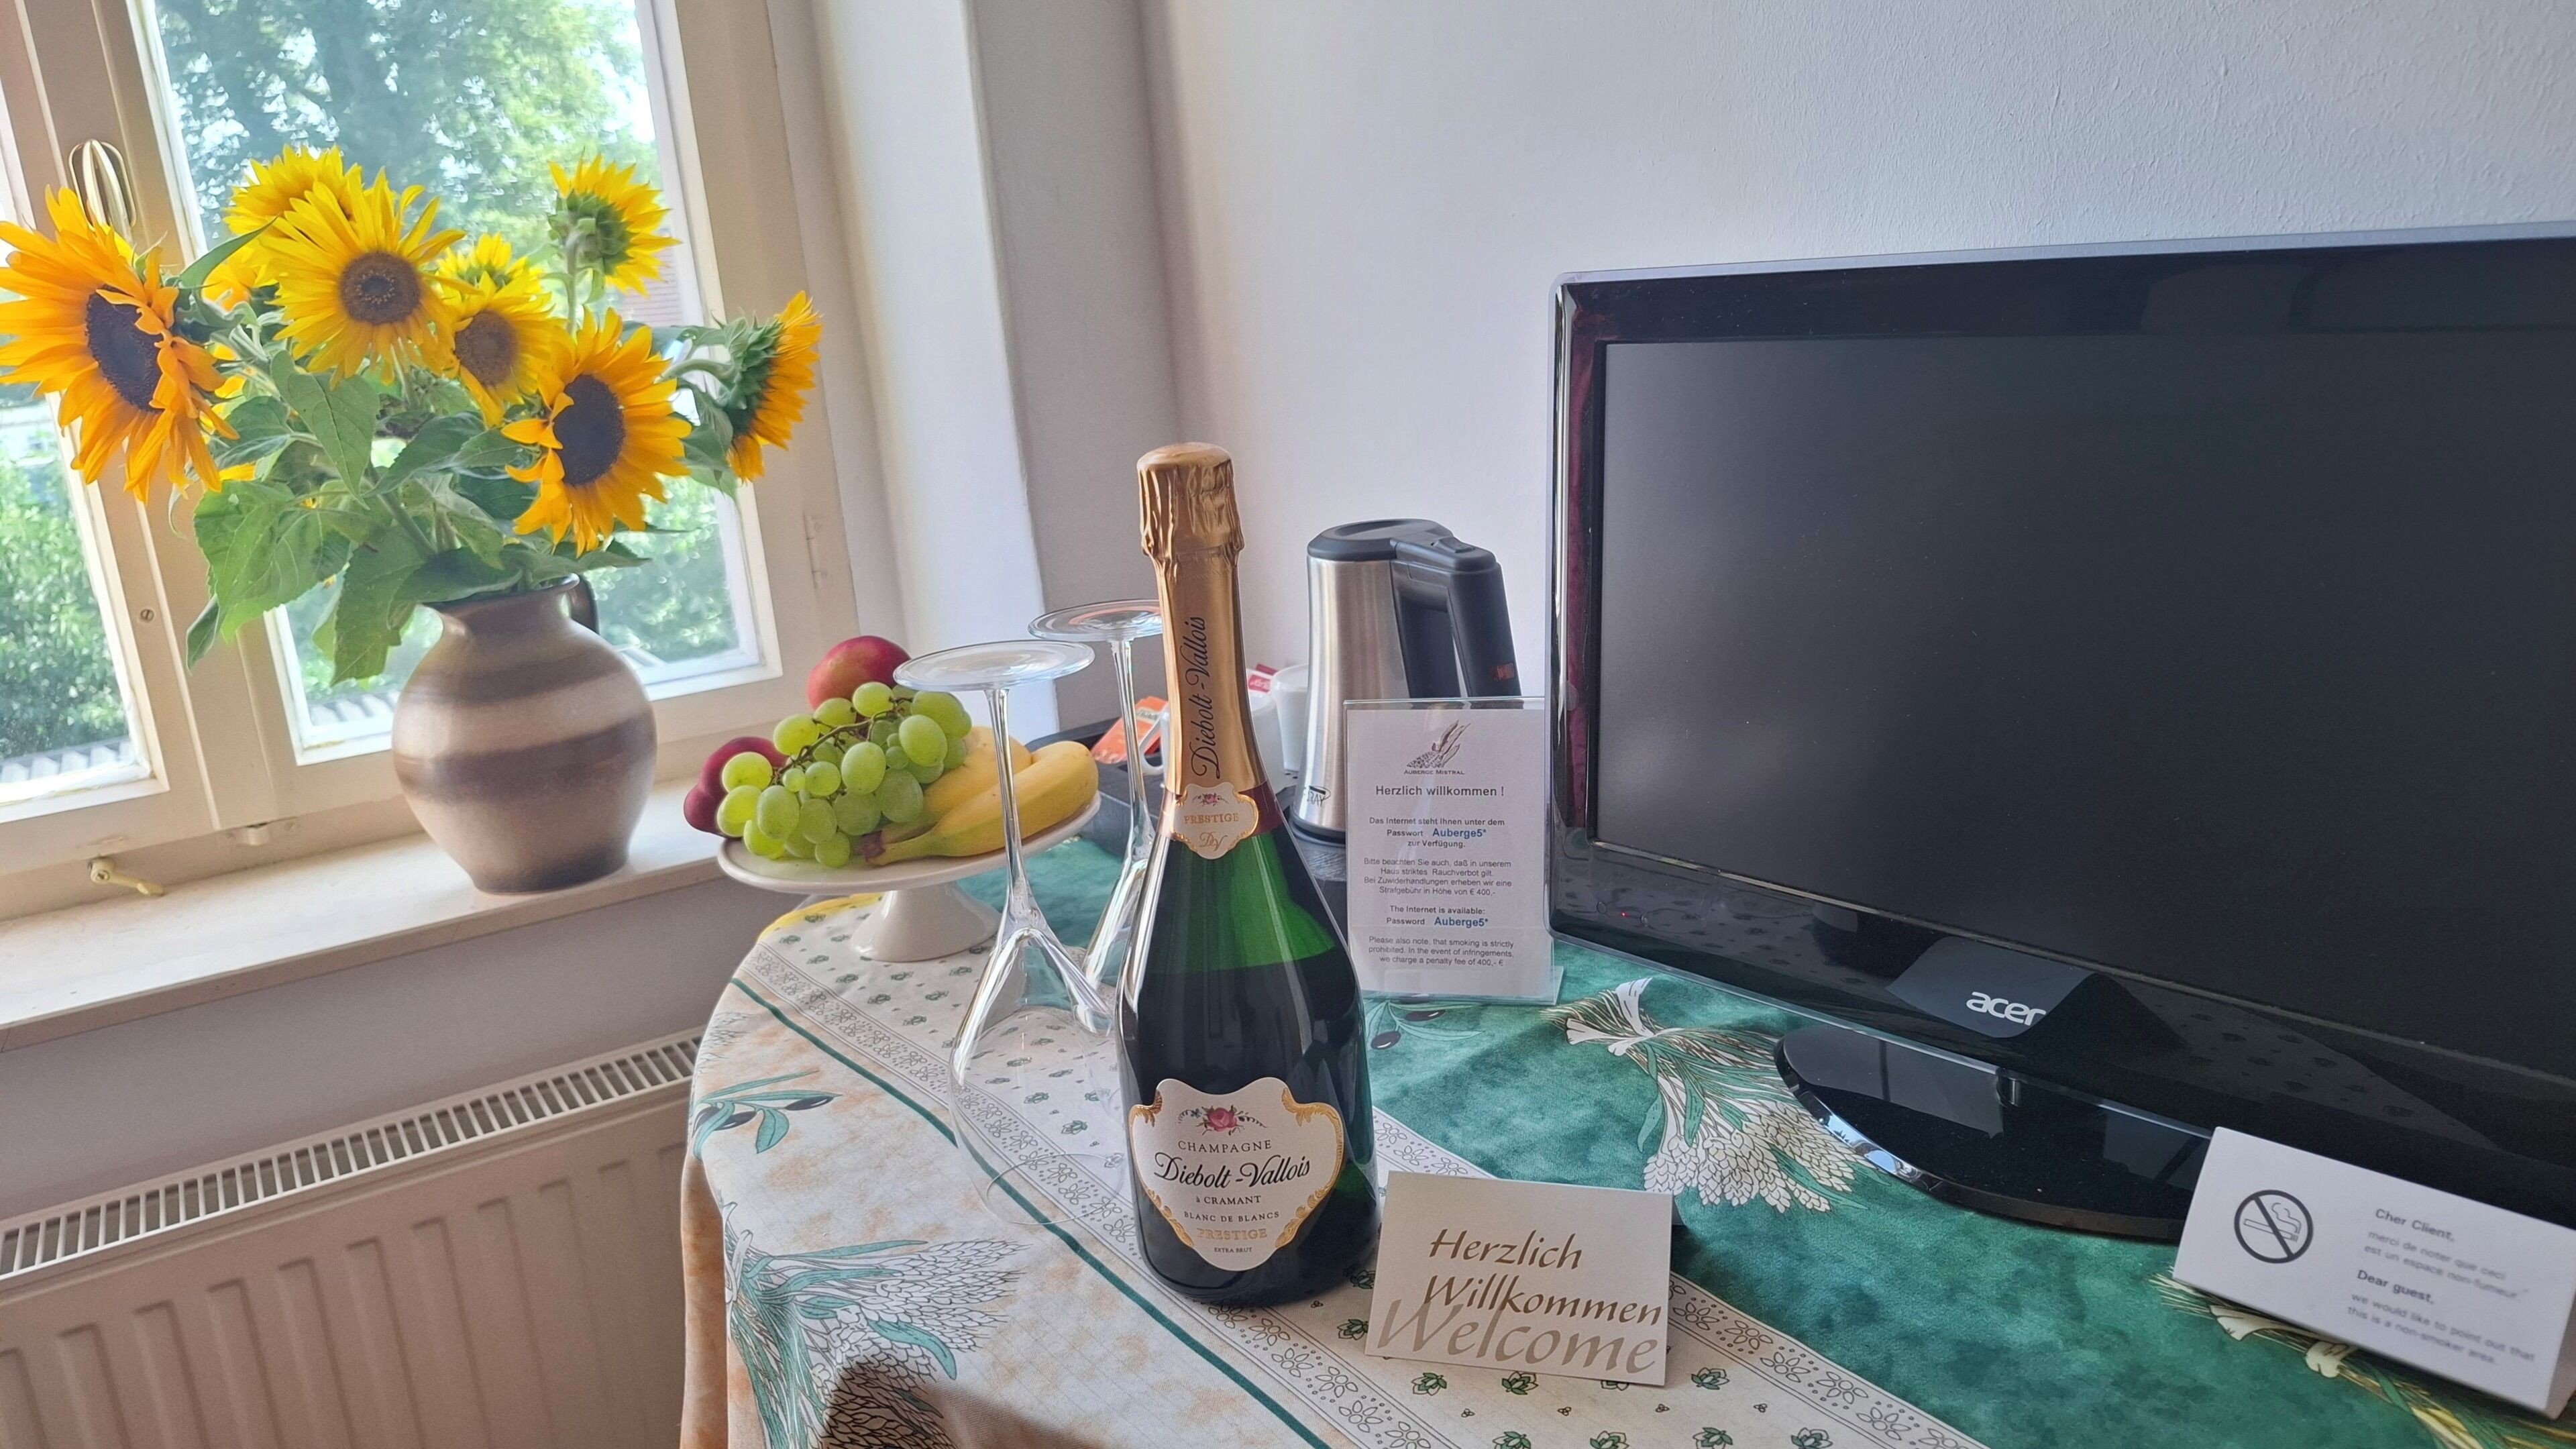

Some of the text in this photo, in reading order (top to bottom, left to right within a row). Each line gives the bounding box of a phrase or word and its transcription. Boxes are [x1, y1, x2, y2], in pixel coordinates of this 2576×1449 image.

[1376, 786, 1422, 795] Herzlich
[1426, 786, 1497, 796] willkommen
[1183, 814, 1239, 824] PRESTIGE
[1422, 840, 1466, 848] Verfügung.
[1378, 877, 1448, 885] Zuwiderhandlungen
[1380, 886, 1421, 895] Strafgebühr
[1449, 939, 1479, 947] smoking
[1491, 941, 1514, 949] strictly
[1462, 949, 1513, 958] infringements,
[1426, 957, 1452, 965] penalty
[1966, 991, 2046, 1026] acer
[1178, 1140, 1272, 1152] CHAMPAGNE
[1203, 1195, 1262, 1205] CRAMANT
[1184, 1212, 1280, 1222] BLANC DE BLANCS
[2375, 1209, 2407, 1226] Cher
[1197, 1228, 1267, 1240] PRESTIGE
[1429, 1229, 1582, 1269] Herzlich
[2364, 1245, 2381, 1256] est
[2385, 1252, 2399, 1261] un
[2403, 1258, 2443, 1276] espace
[2368, 1231, 2506, 1280] merci de noter que ceci
[2357, 1270, 2388, 1287] Dear
[1424, 1273, 1662, 1326] Willkommen
[2348, 1307, 2367, 1320] this
[2371, 1315, 2380, 1324] is
[2395, 1324, 2464, 1352] non-smoker
[2352, 1294, 2534, 1362] we would like to point out that
[1378, 1299, 1658, 1373] Welcome
